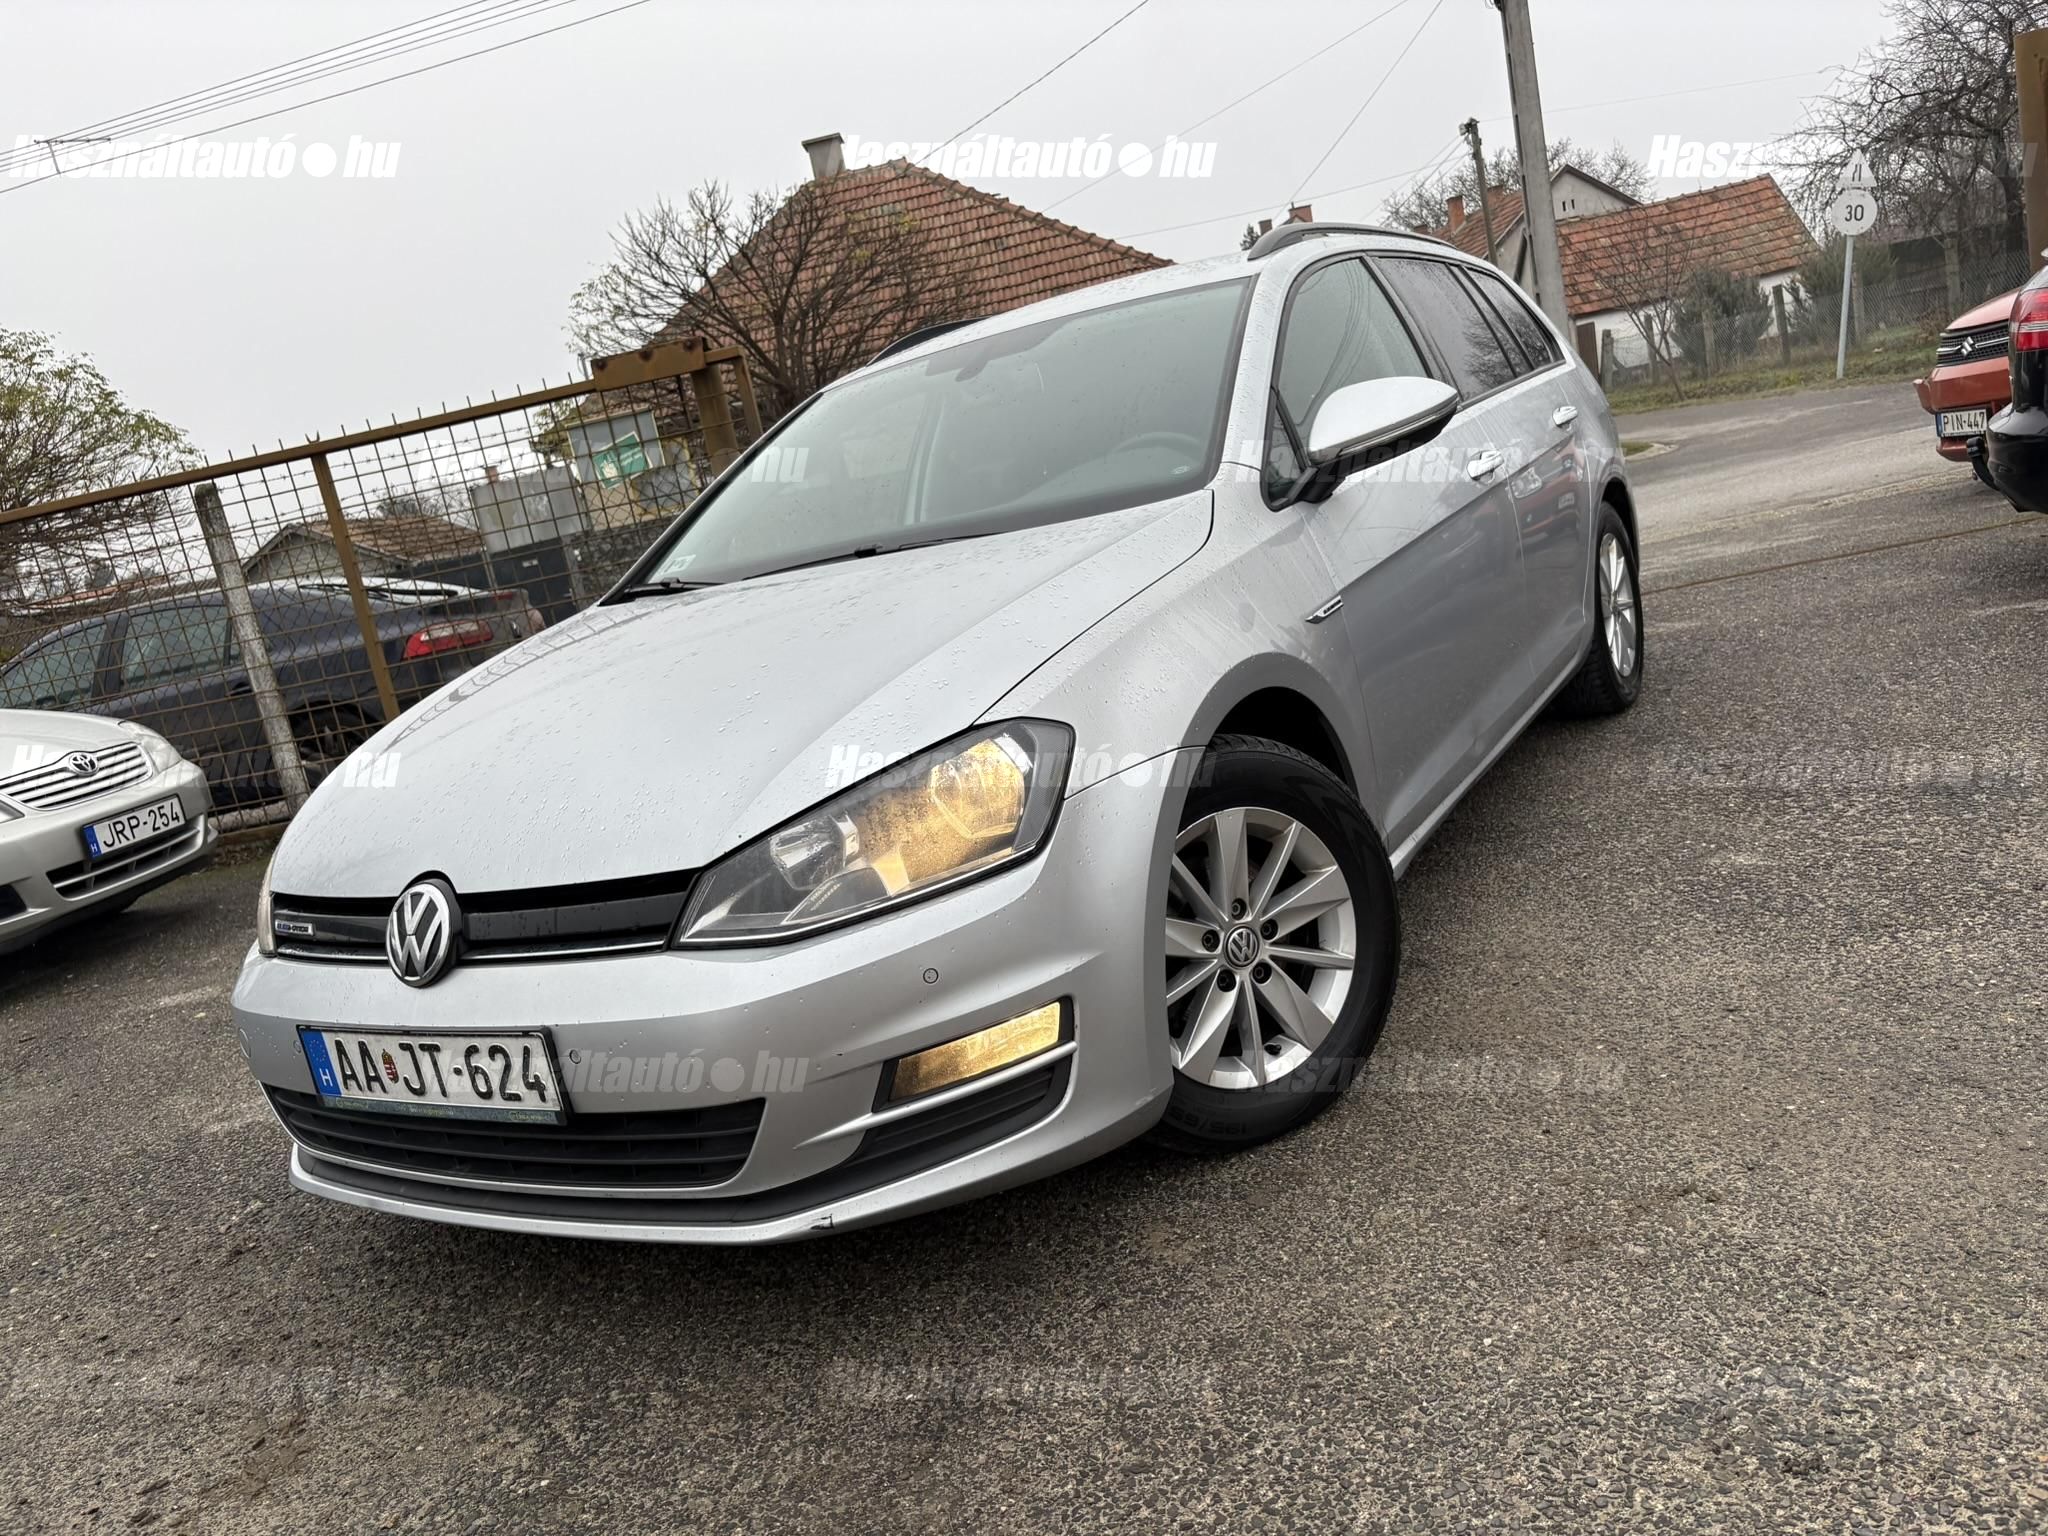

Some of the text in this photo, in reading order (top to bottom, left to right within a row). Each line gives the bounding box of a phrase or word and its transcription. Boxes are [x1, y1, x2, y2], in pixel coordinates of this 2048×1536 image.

[1844, 203, 1865, 223] 30
[103, 802, 180, 848] JRP-254
[333, 1038, 388, 1094] AA
